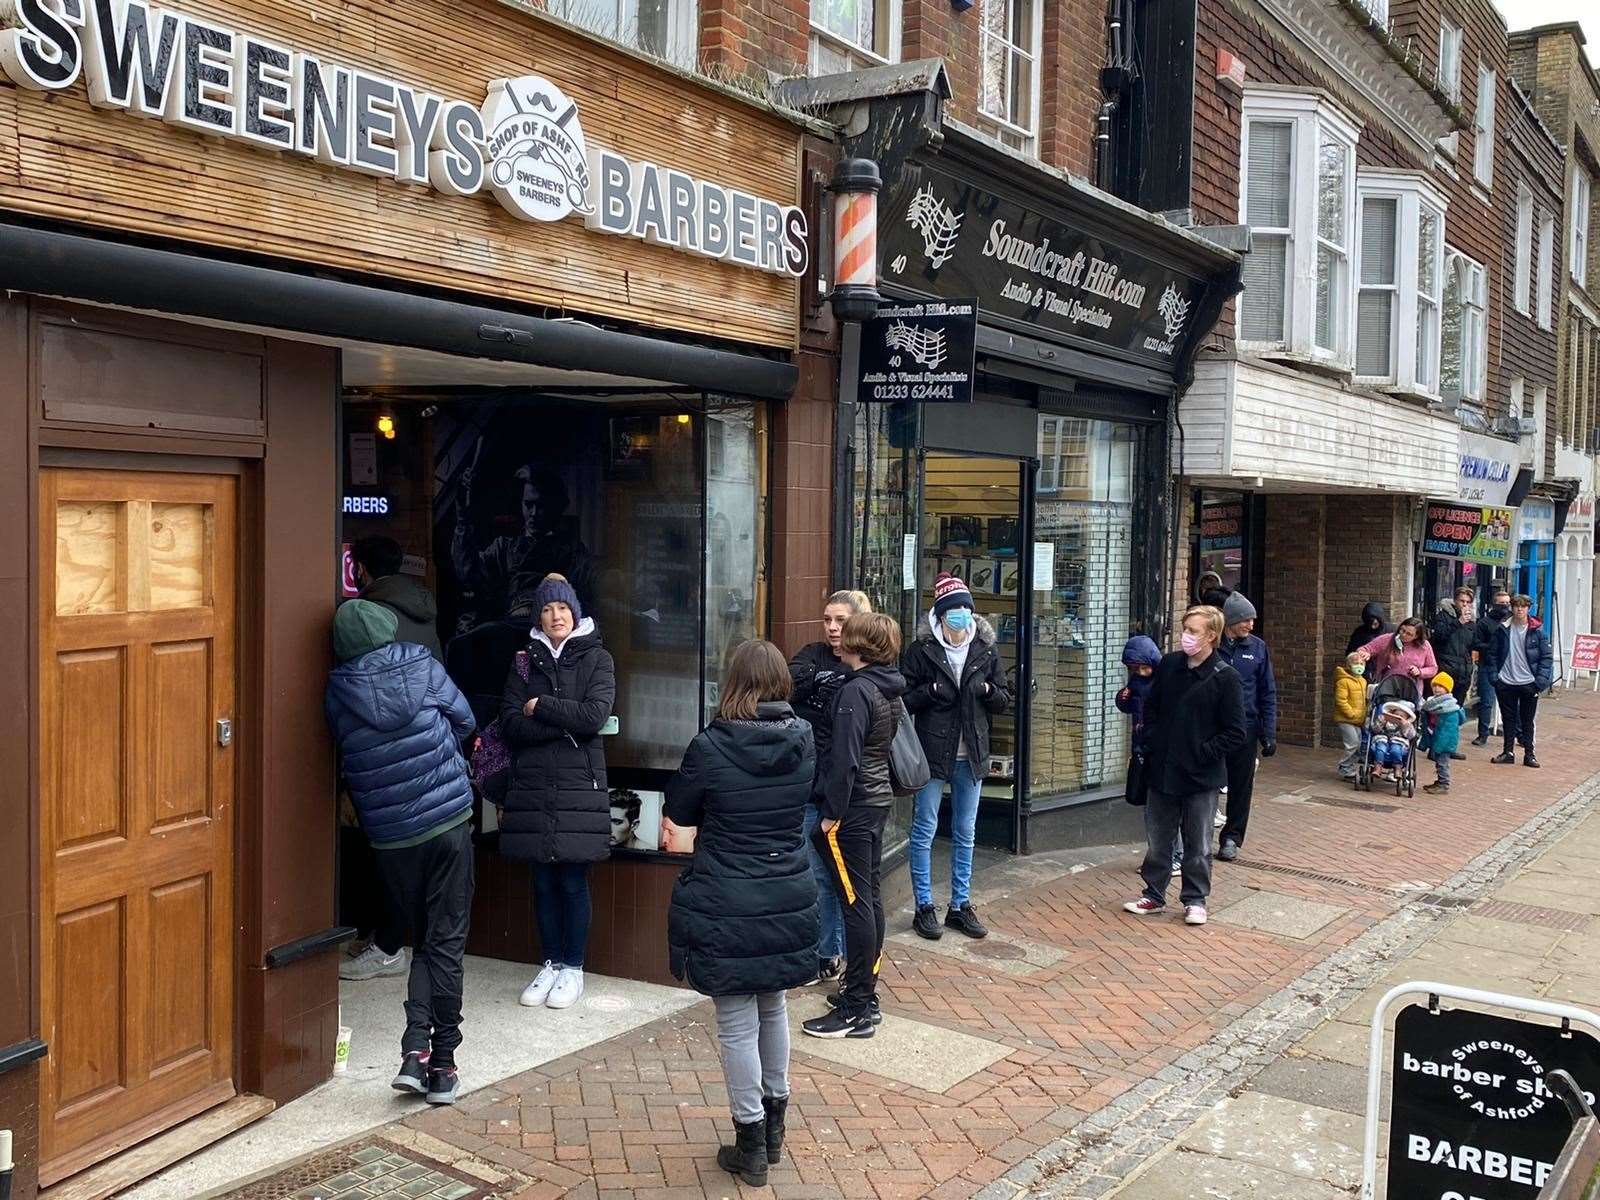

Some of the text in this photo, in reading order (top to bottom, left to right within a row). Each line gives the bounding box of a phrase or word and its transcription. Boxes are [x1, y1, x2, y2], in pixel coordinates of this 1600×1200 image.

[15, 0, 809, 277] SWEENEYS BARBERS
[489, 123, 519, 158] SHOP
[522, 121, 538, 136] OF
[516, 170, 564, 194] SWEENEYS
[519, 186, 561, 207] BARBERS
[890, 254, 907, 274] 40
[982, 218, 1147, 309] Soundcraft Hifi.com
[925, 303, 972, 316] Hifi.com
[1000, 278, 1113, 329] Audio & Visual Specialists
[888, 355, 902, 368] 40
[863, 372, 968, 384] Audio & Visual Specialists
[874, 385, 954, 399] 01233 624441
[1446, 510, 1481, 524] LICENCE
[1433, 523, 1473, 540] OPEN
[1425, 540, 1458, 554] EARLY
[1481, 548, 1505, 559] LATE
[1452, 1040, 1544, 1076] Sweeneys
[1403, 1053, 1596, 1107] barber shp
[1453, 1084, 1545, 1120] of Ashford
